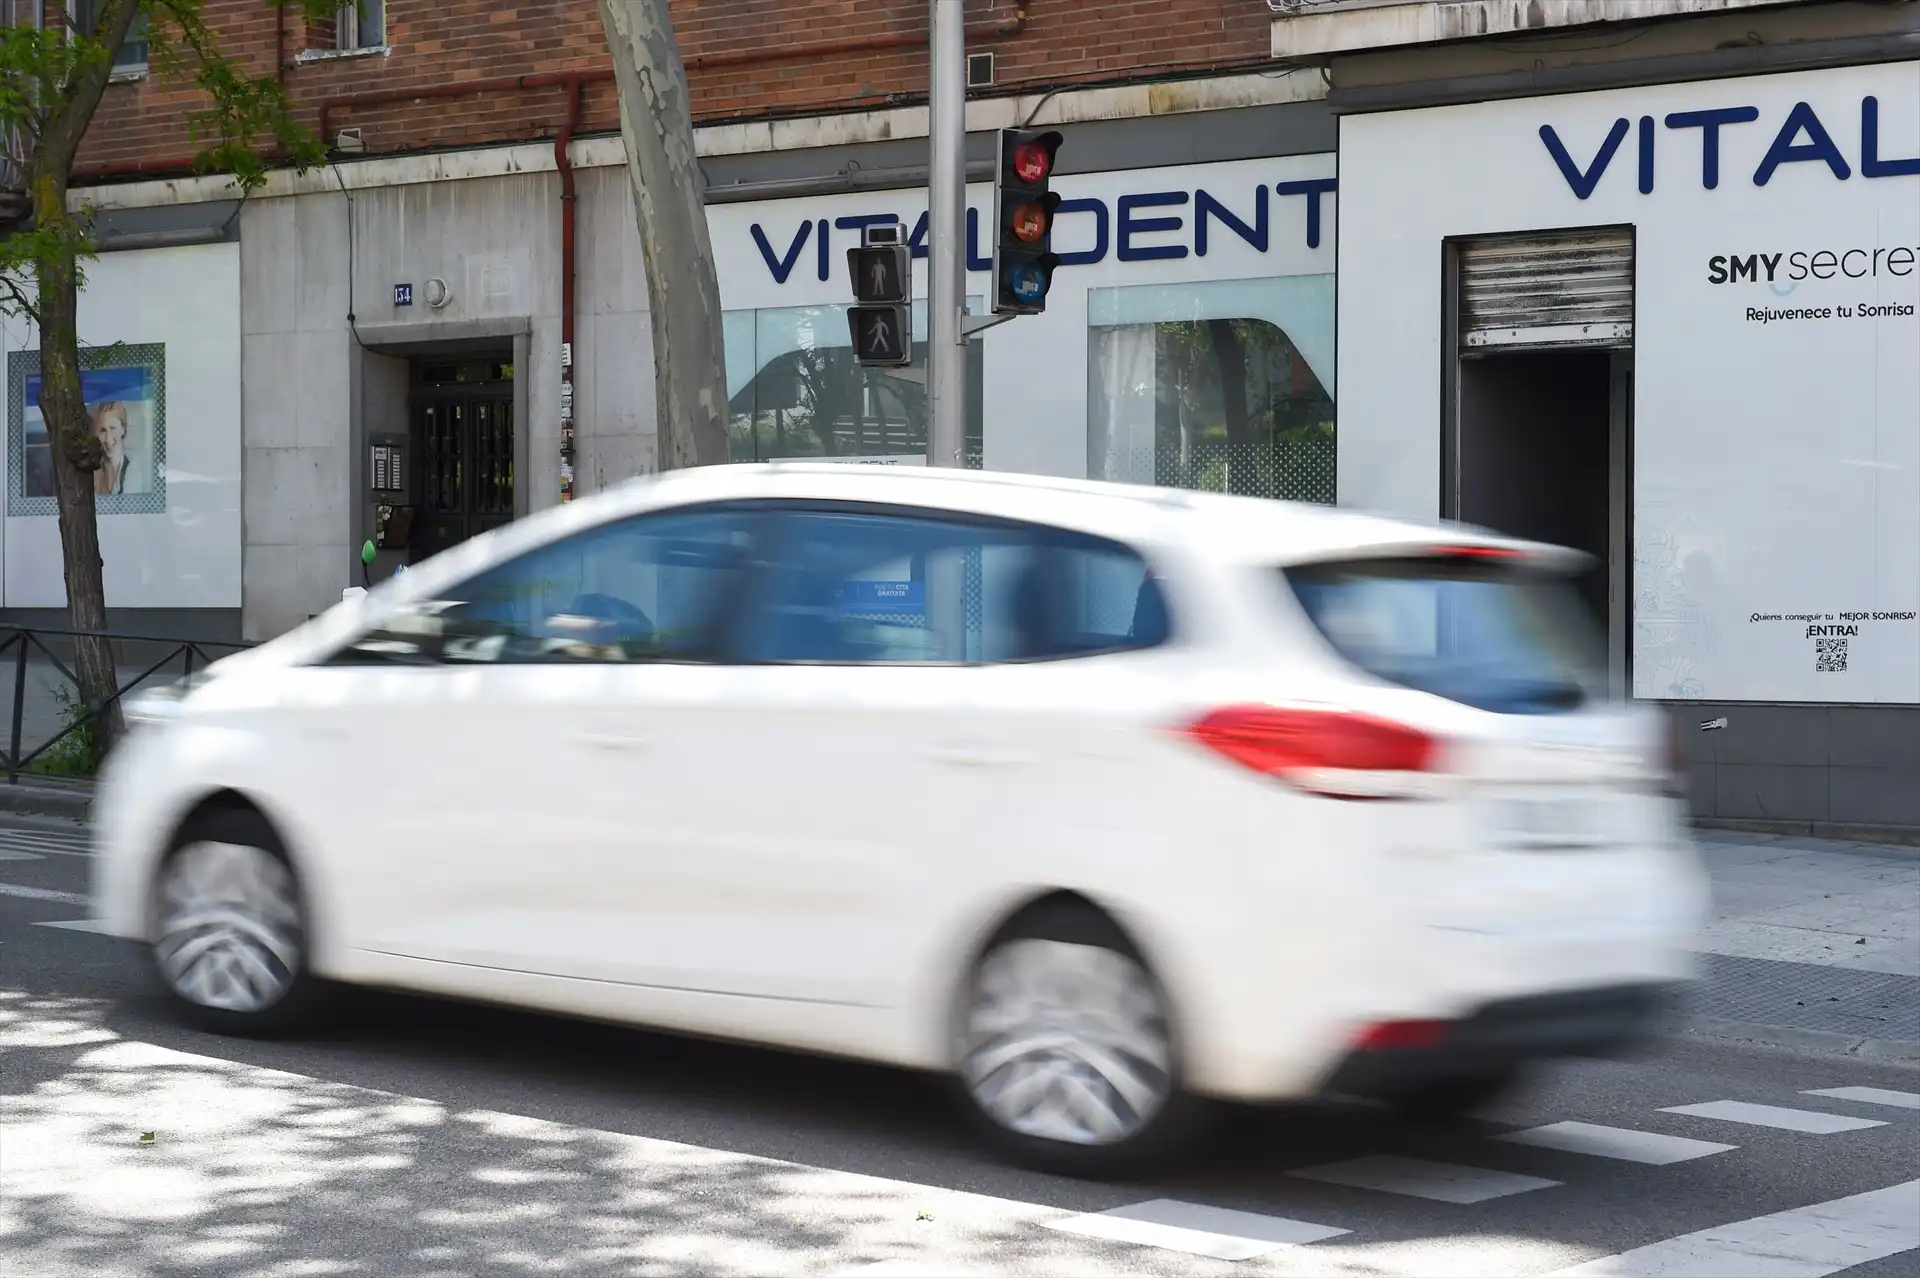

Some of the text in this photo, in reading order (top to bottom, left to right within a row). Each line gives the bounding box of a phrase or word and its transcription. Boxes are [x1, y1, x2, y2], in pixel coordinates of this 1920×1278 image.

[1538, 95, 1920, 200] VITAL
[394, 287, 411, 303] 134
[1746, 302, 1914, 324] Rejuvenece tu Sonrisa
[1750, 613, 1782, 622] ¿Quieres
[1785, 612, 1822, 622] conseguir
[1839, 612, 1869, 621] MEJOR
[1872, 612, 1917, 620] SONRISA?
[1805, 625, 1858, 638] ¡ENTRA!
